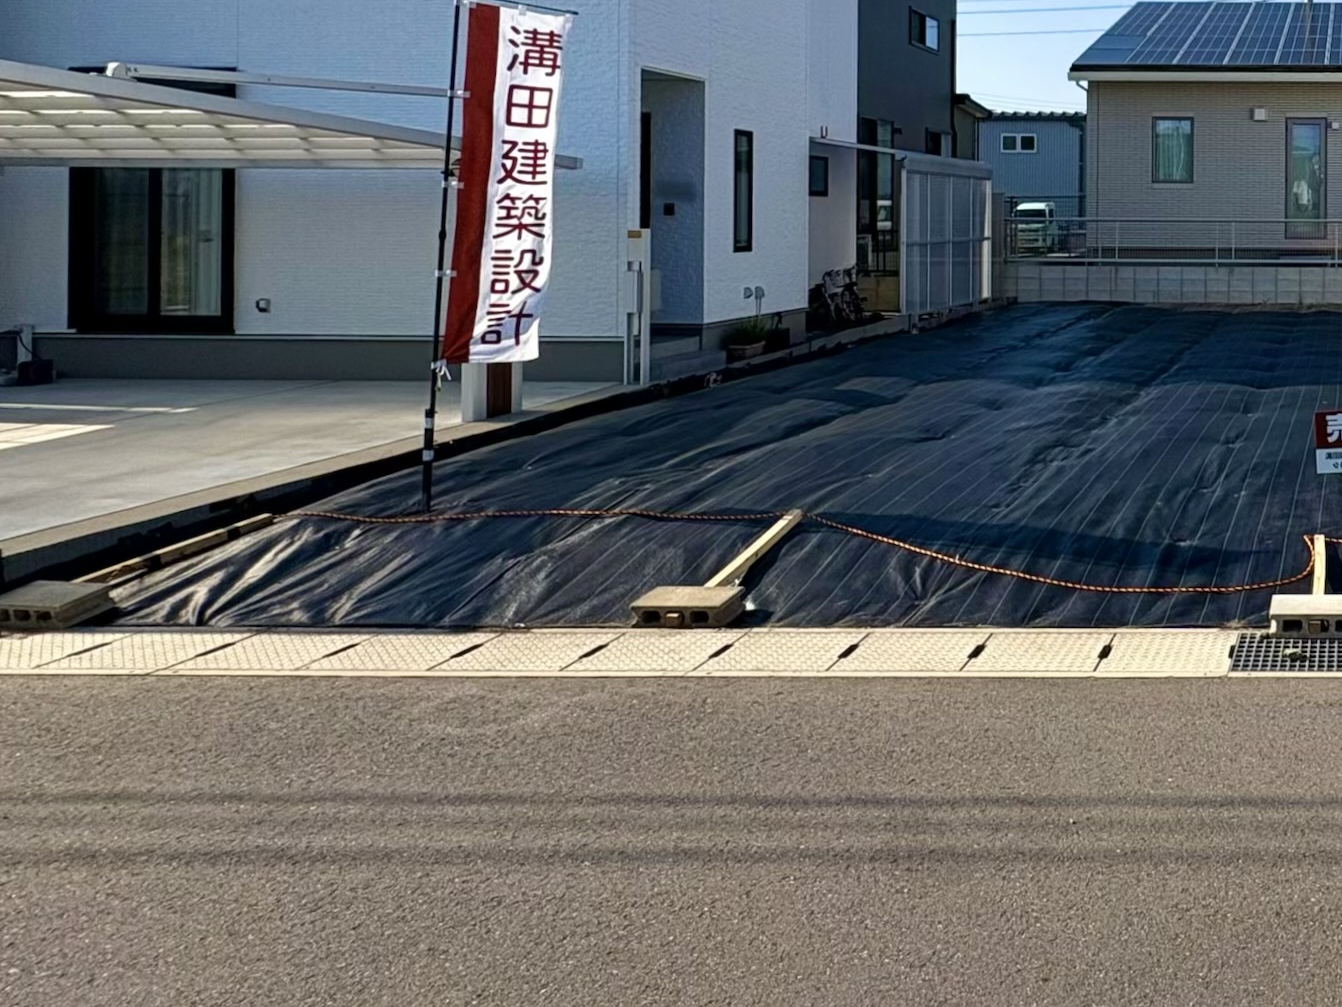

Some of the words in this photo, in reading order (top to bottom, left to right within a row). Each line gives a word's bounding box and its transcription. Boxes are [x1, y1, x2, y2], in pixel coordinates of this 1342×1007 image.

[481, 25, 563, 346] 溝田建築設計
